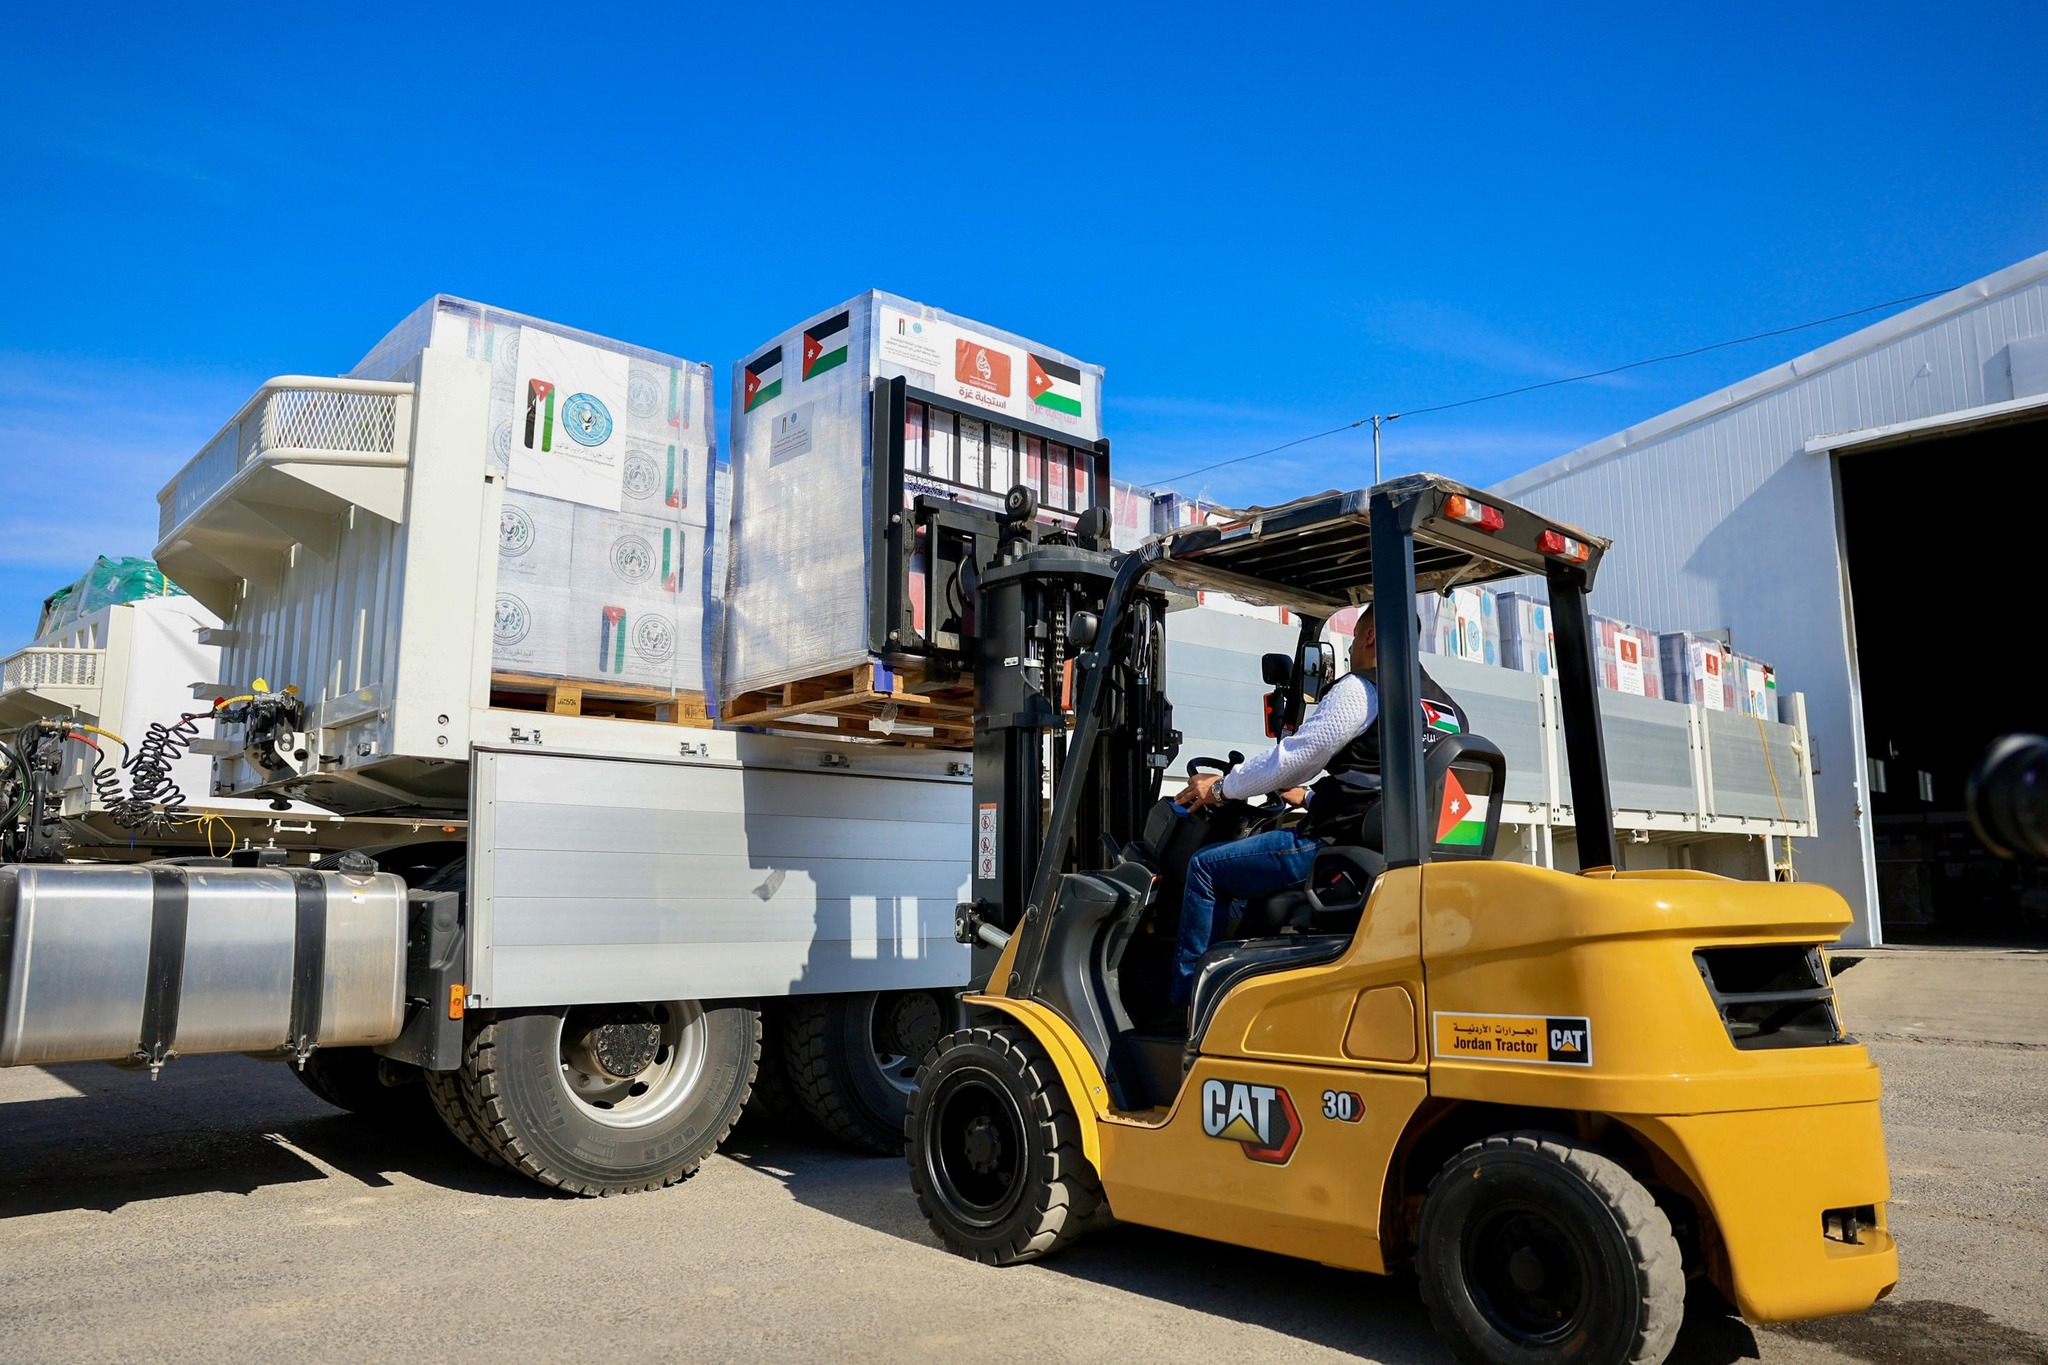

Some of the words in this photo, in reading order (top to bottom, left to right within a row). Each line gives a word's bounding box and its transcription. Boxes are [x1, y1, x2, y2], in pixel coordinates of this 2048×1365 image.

[958, 386, 973, 399] غزة
[975, 391, 1007, 409] استجابة
[1453, 1022, 1492, 1035] الأردنية
[1494, 1024, 1538, 1038] الجرارات
[1453, 1036, 1492, 1051] Jordan
[1495, 1038, 1538, 1053] Tractor
[1550, 1029, 1584, 1052] CAT
[1202, 1080, 1276, 1145] CAT
[1323, 1090, 1352, 1121] 30
